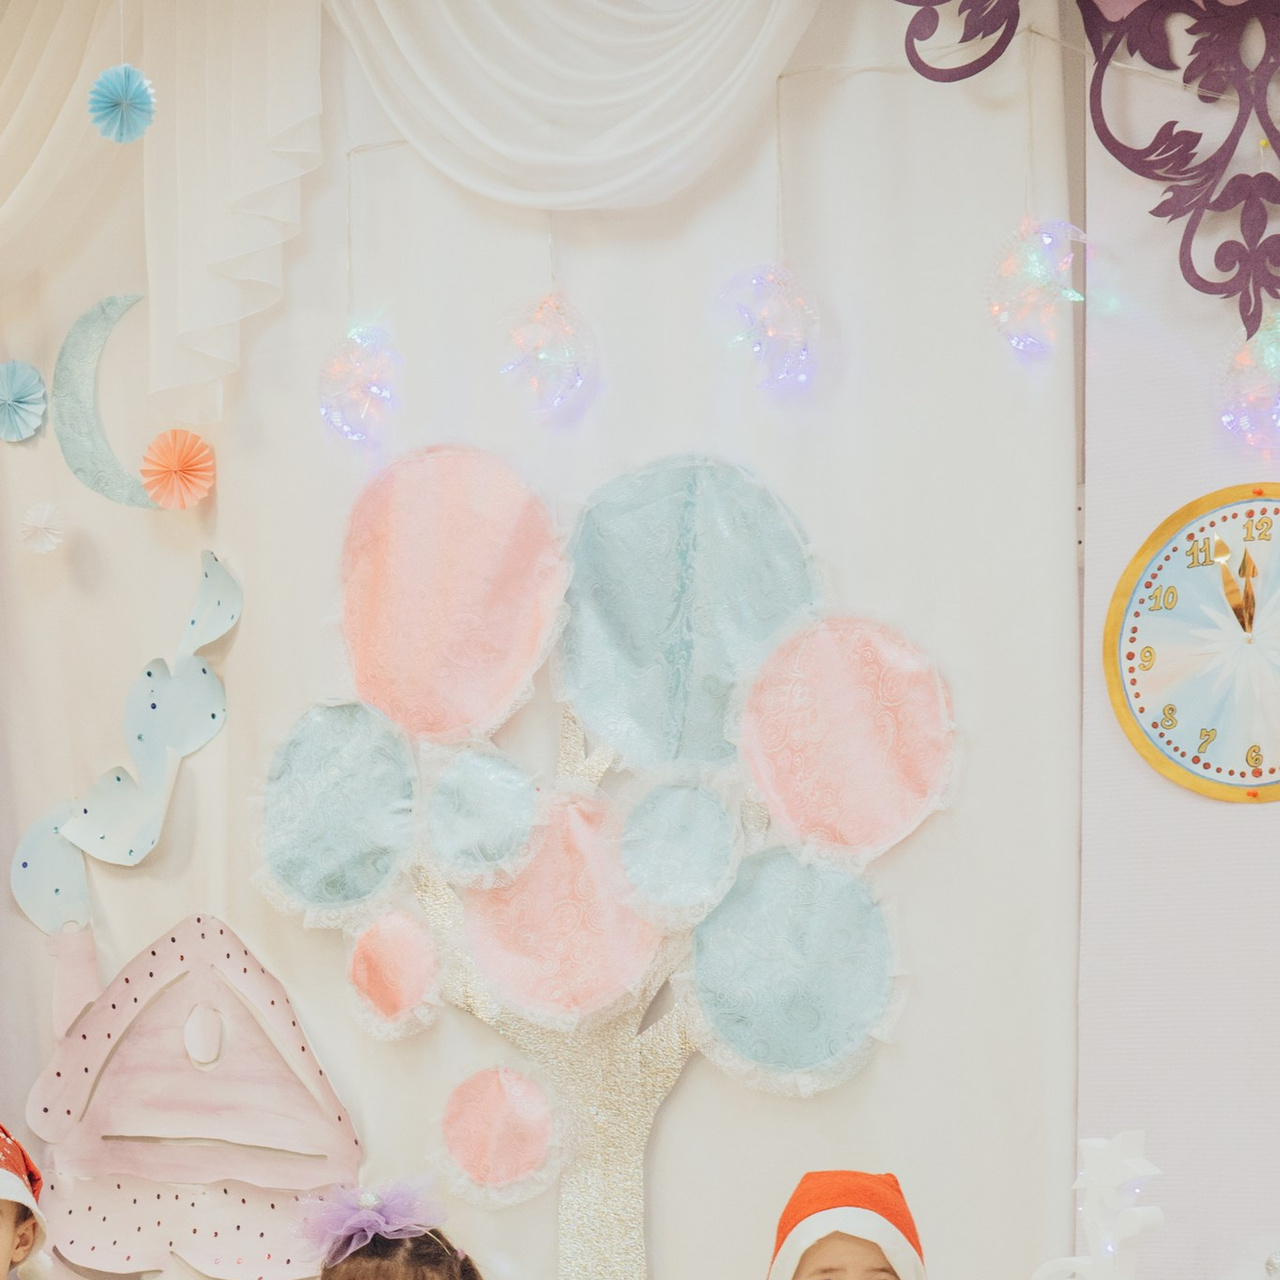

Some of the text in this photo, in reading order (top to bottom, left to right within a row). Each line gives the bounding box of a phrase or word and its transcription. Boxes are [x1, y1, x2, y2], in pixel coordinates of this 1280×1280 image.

[1242, 516, 1273, 541] 12
[1185, 537, 1214, 569] 11
[1148, 585, 1178, 611] 10
[1138, 646, 1156, 671] 9
[1160, 704, 1178, 730] 8
[1197, 728, 1217, 753] 7
[1245, 744, 1263, 768] 6
